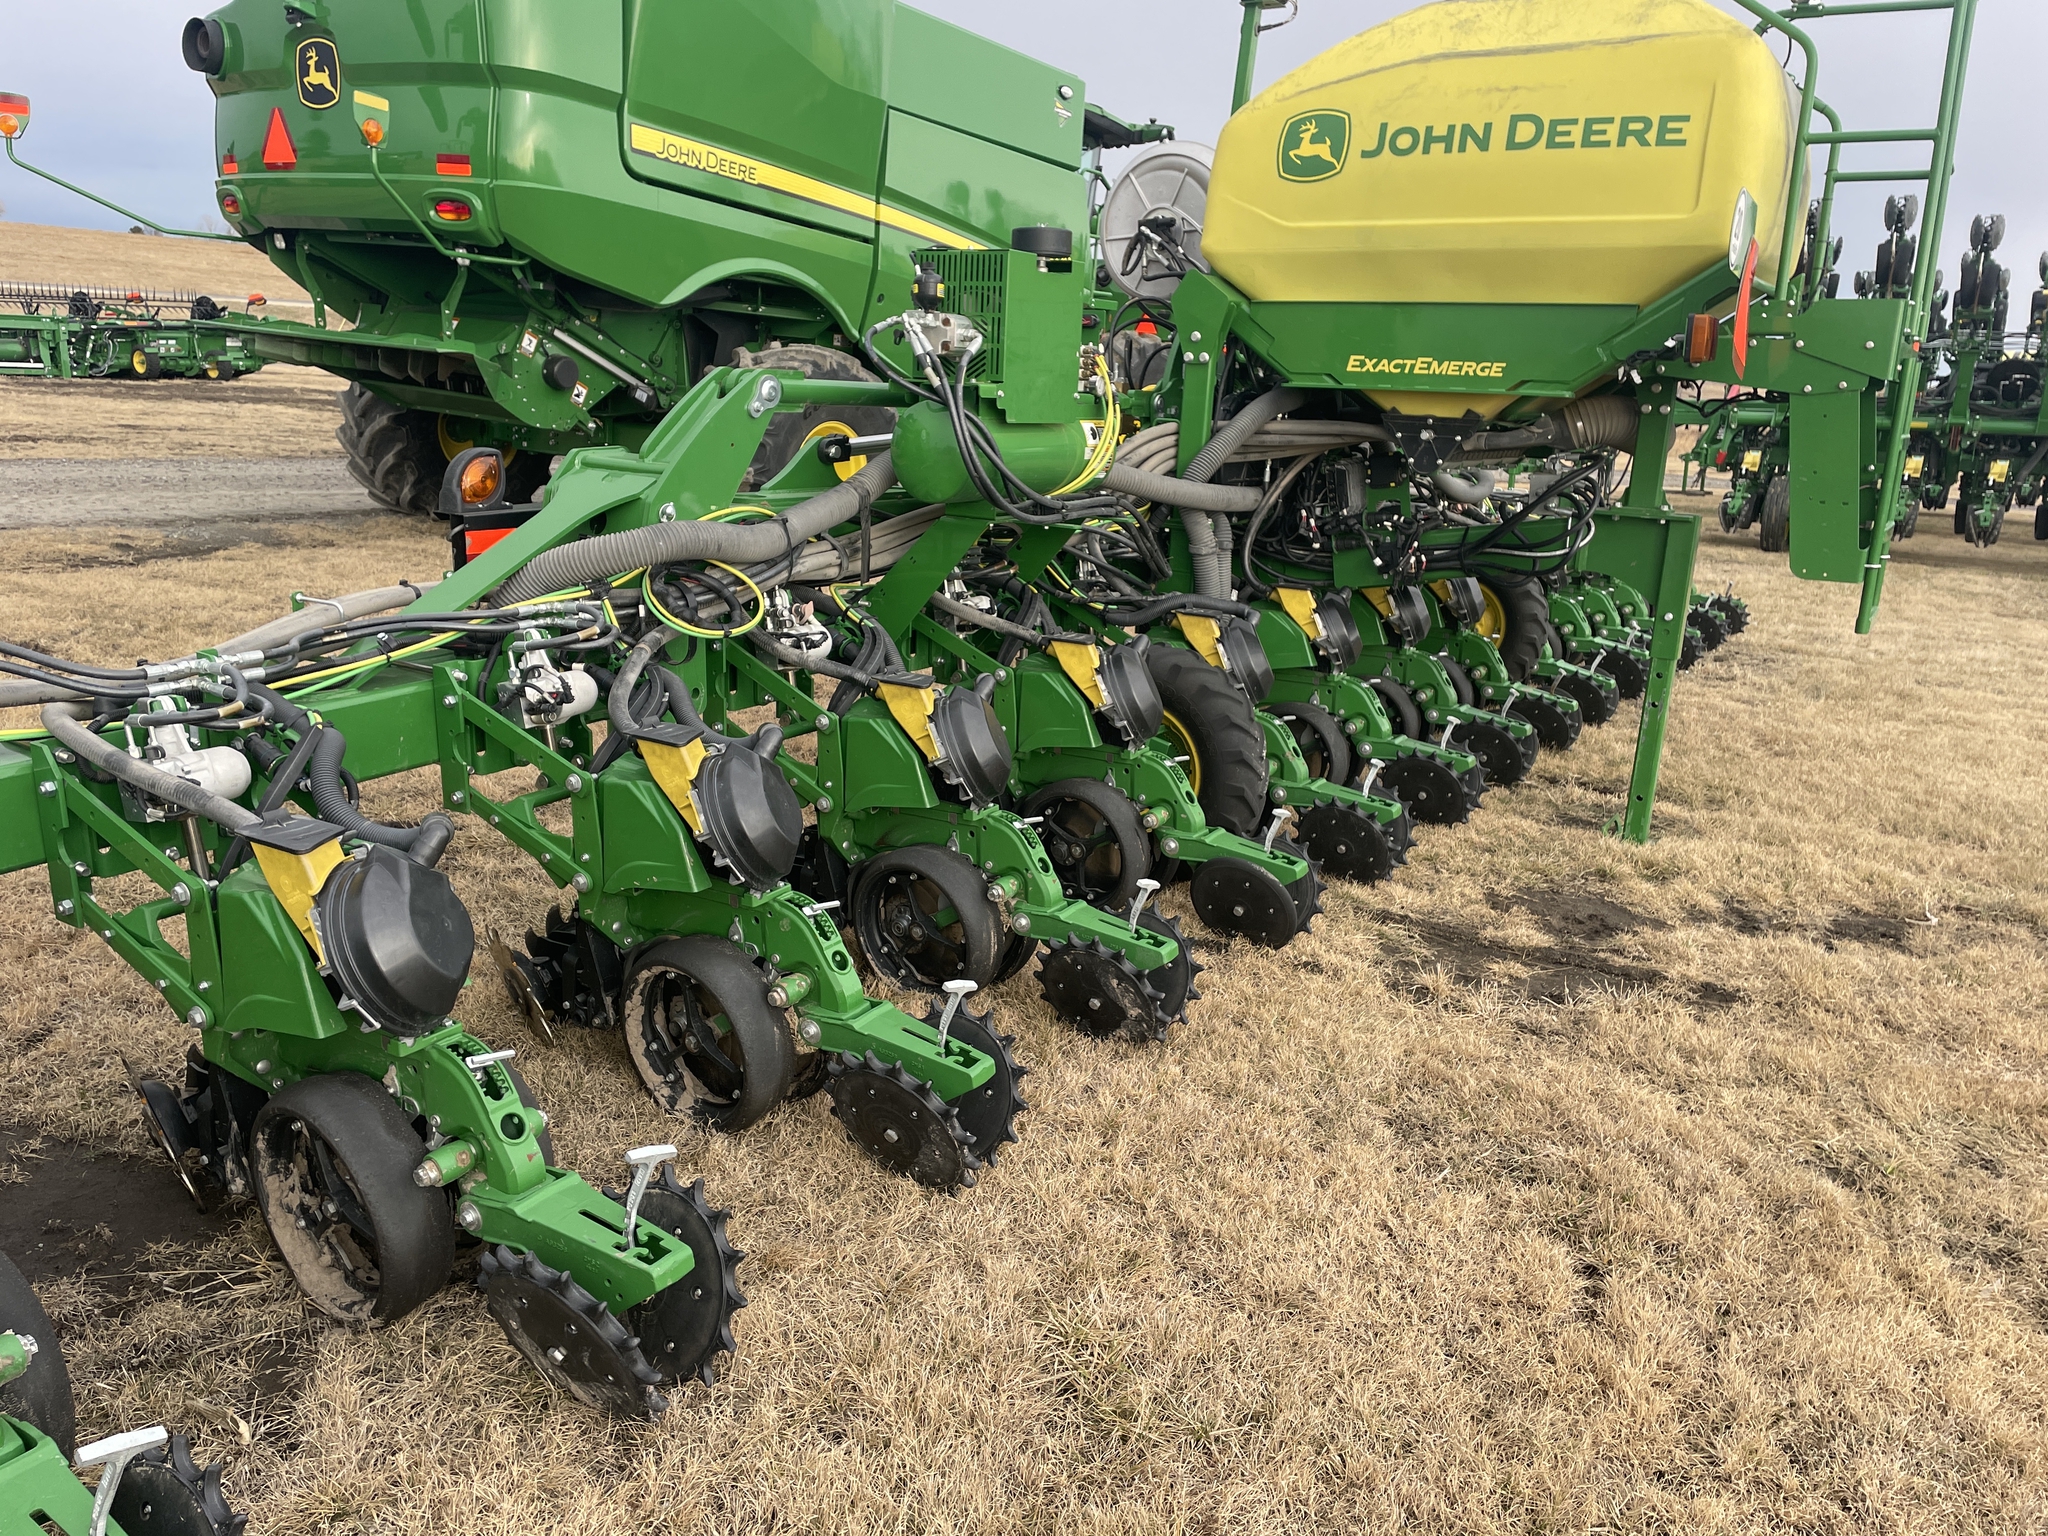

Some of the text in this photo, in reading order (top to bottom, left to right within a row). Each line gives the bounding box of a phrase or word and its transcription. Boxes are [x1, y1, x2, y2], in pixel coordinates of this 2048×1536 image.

[1360, 113, 1692, 159] JOHN DEERE
[657, 138, 757, 180] JOHN DEERE
